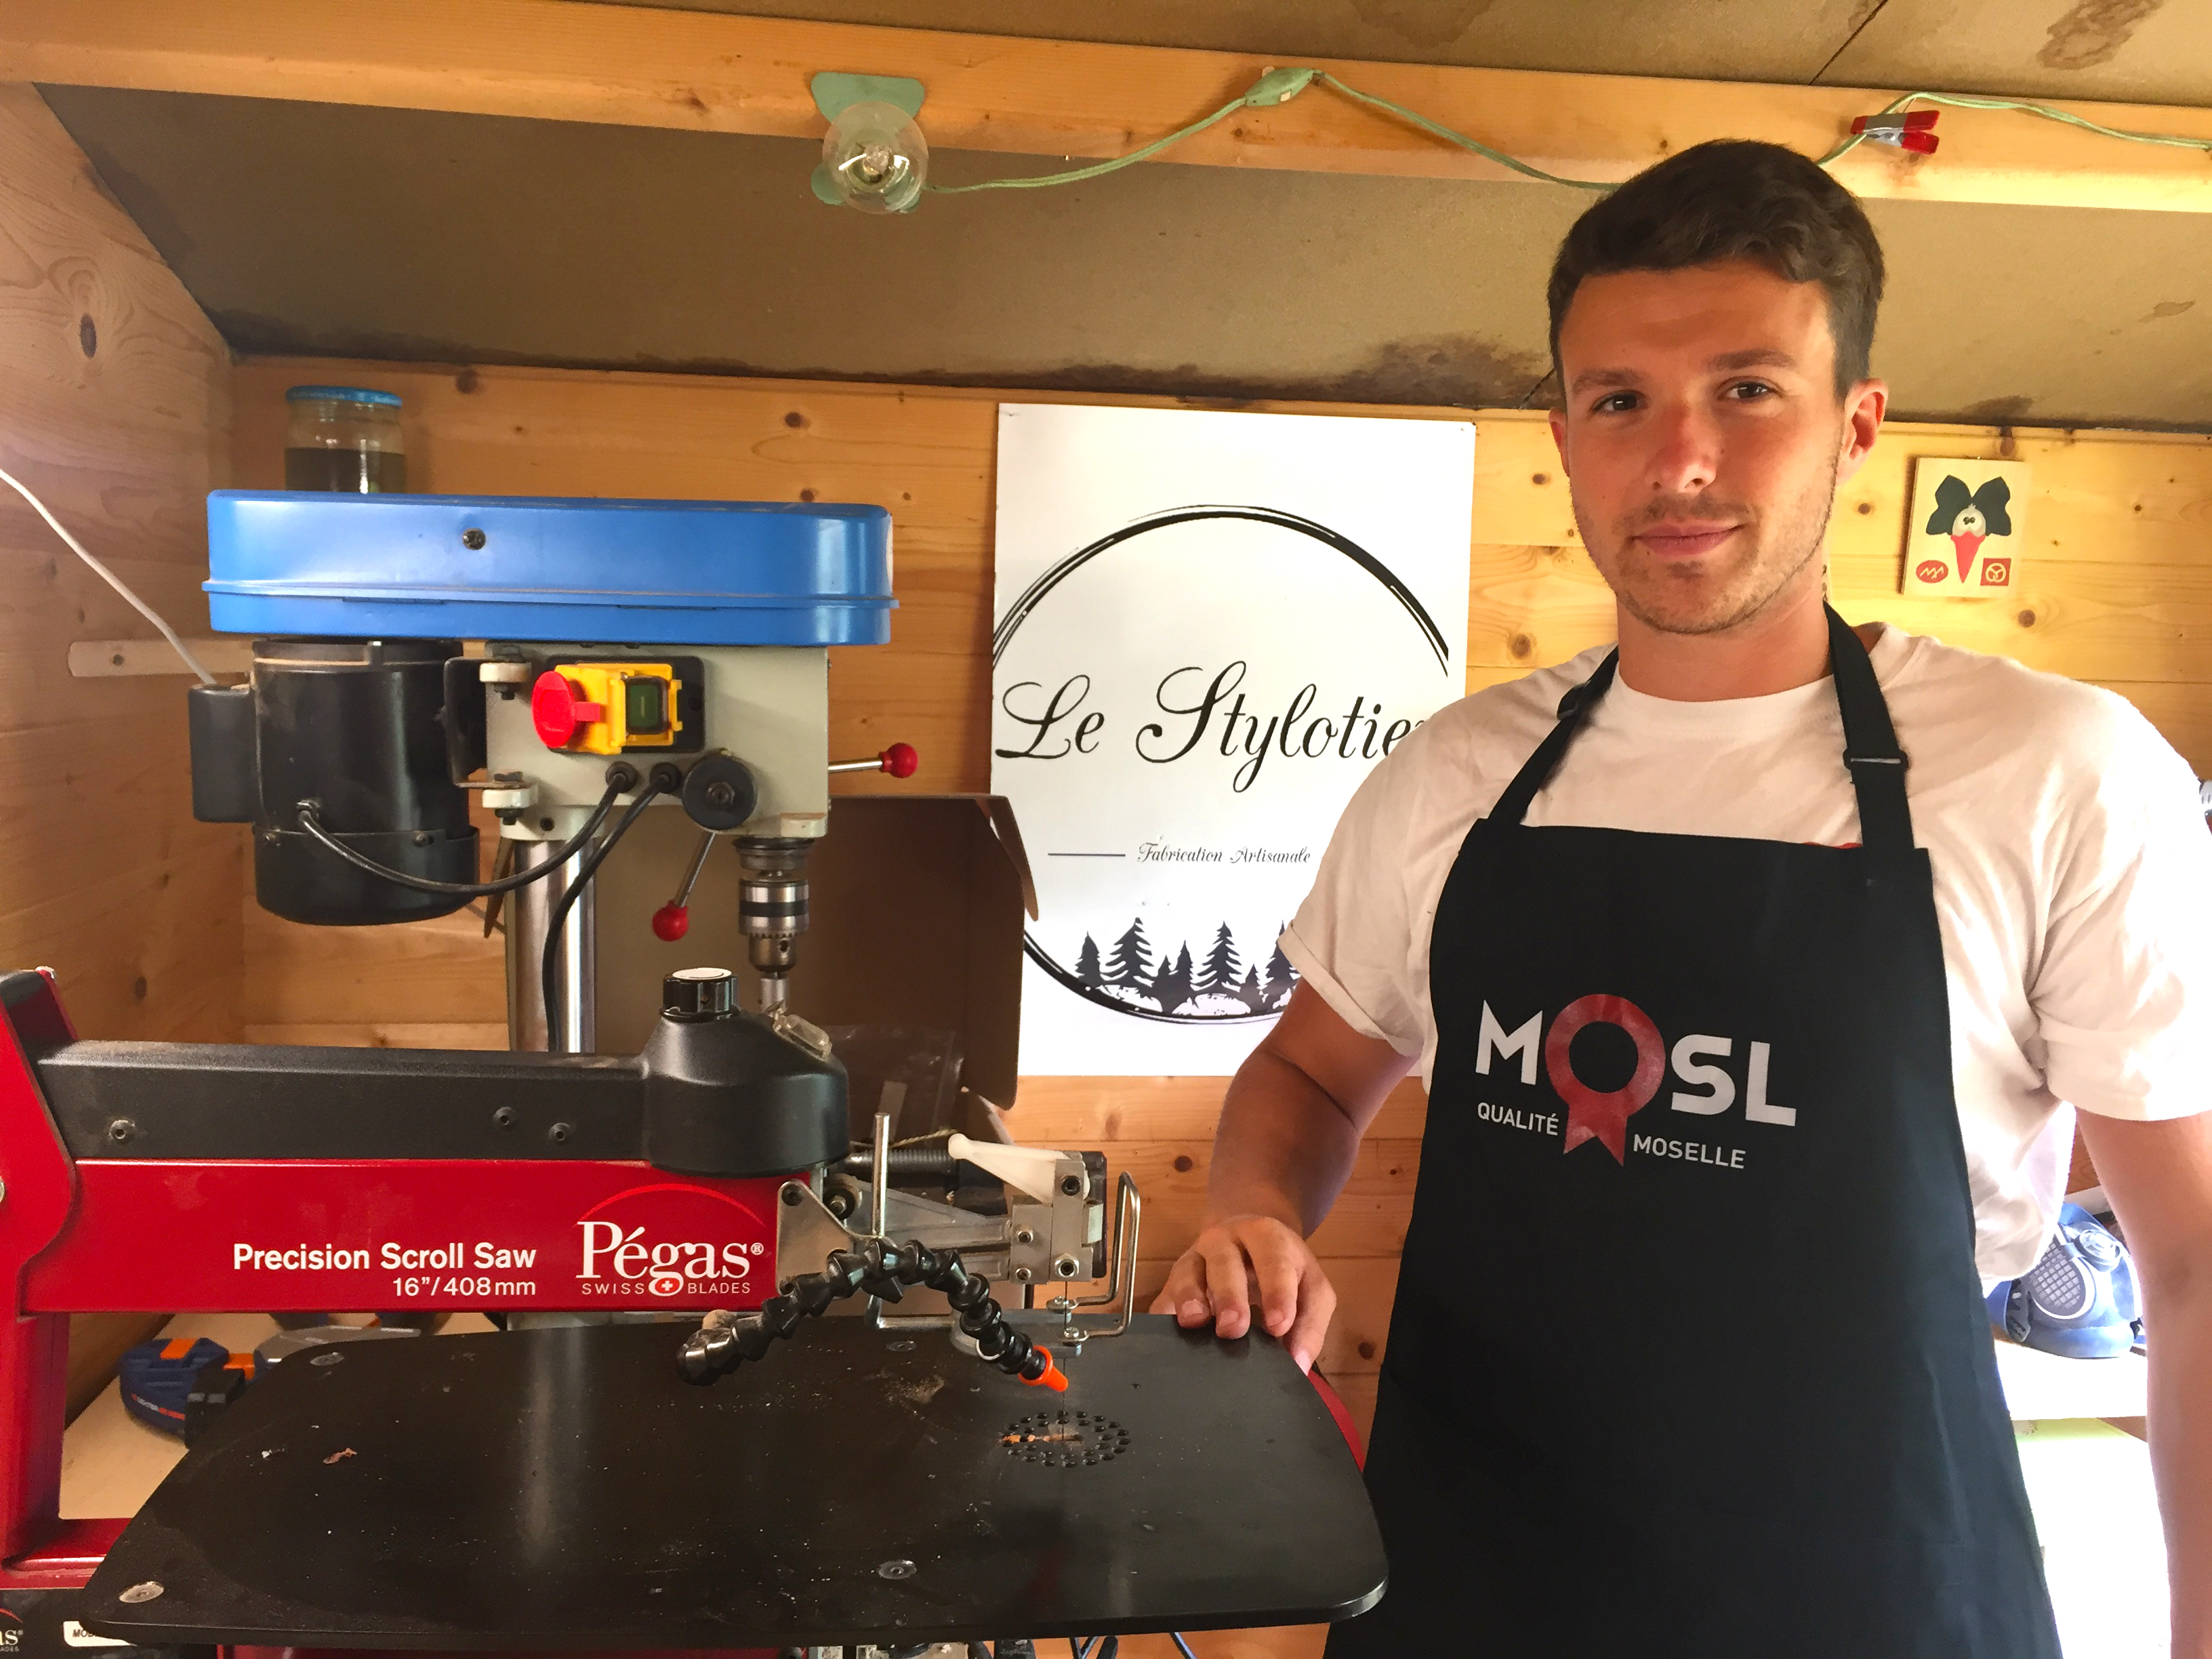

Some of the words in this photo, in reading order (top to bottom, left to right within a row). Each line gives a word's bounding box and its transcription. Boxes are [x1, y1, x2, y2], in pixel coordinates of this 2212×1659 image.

[994, 674, 1105, 760] Le
[1135, 660, 1425, 793] Stylotie
[1136, 842, 1223, 863] Fabrication
[1229, 845, 1311, 864] Artisanale
[1475, 994, 1797, 1128] MOSL
[1477, 1102, 1559, 1136] QUALITÉ
[1633, 1133, 1746, 1170] MOSELLE
[233, 1242, 371, 1271] Precision
[380, 1242, 464, 1269] Scroll
[473, 1242, 537, 1269] Saw
[581, 1282, 644, 1295] SWISS
[687, 1282, 751, 1294] BLADES
